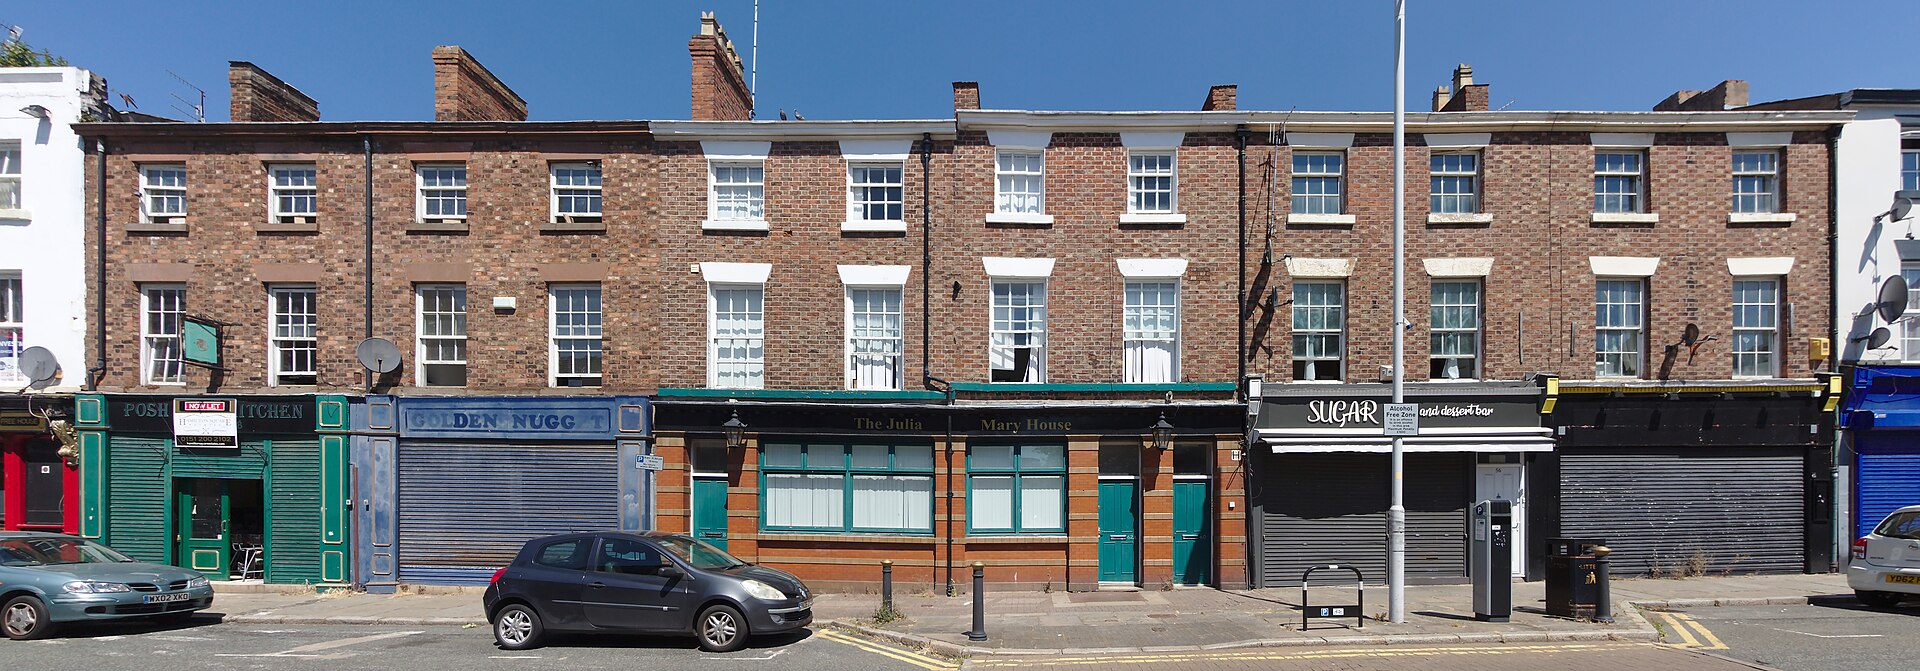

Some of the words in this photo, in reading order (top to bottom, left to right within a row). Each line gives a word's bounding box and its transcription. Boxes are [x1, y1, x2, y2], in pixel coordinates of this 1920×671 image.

[123, 403, 169, 418] POSH
[236, 403, 303, 419] ITCHEN
[1307, 400, 1379, 427] SUGAR
[1419, 405, 1439, 417] and
[1440, 404, 1474, 417] dessert
[1475, 404, 1494, 417] bar
[411, 413, 498, 430] GOLDEN
[854, 417, 882, 430] The
[886, 417, 923, 431] Julia
[980, 419, 1021, 433] Mary
[1027, 418, 1072, 431] House
